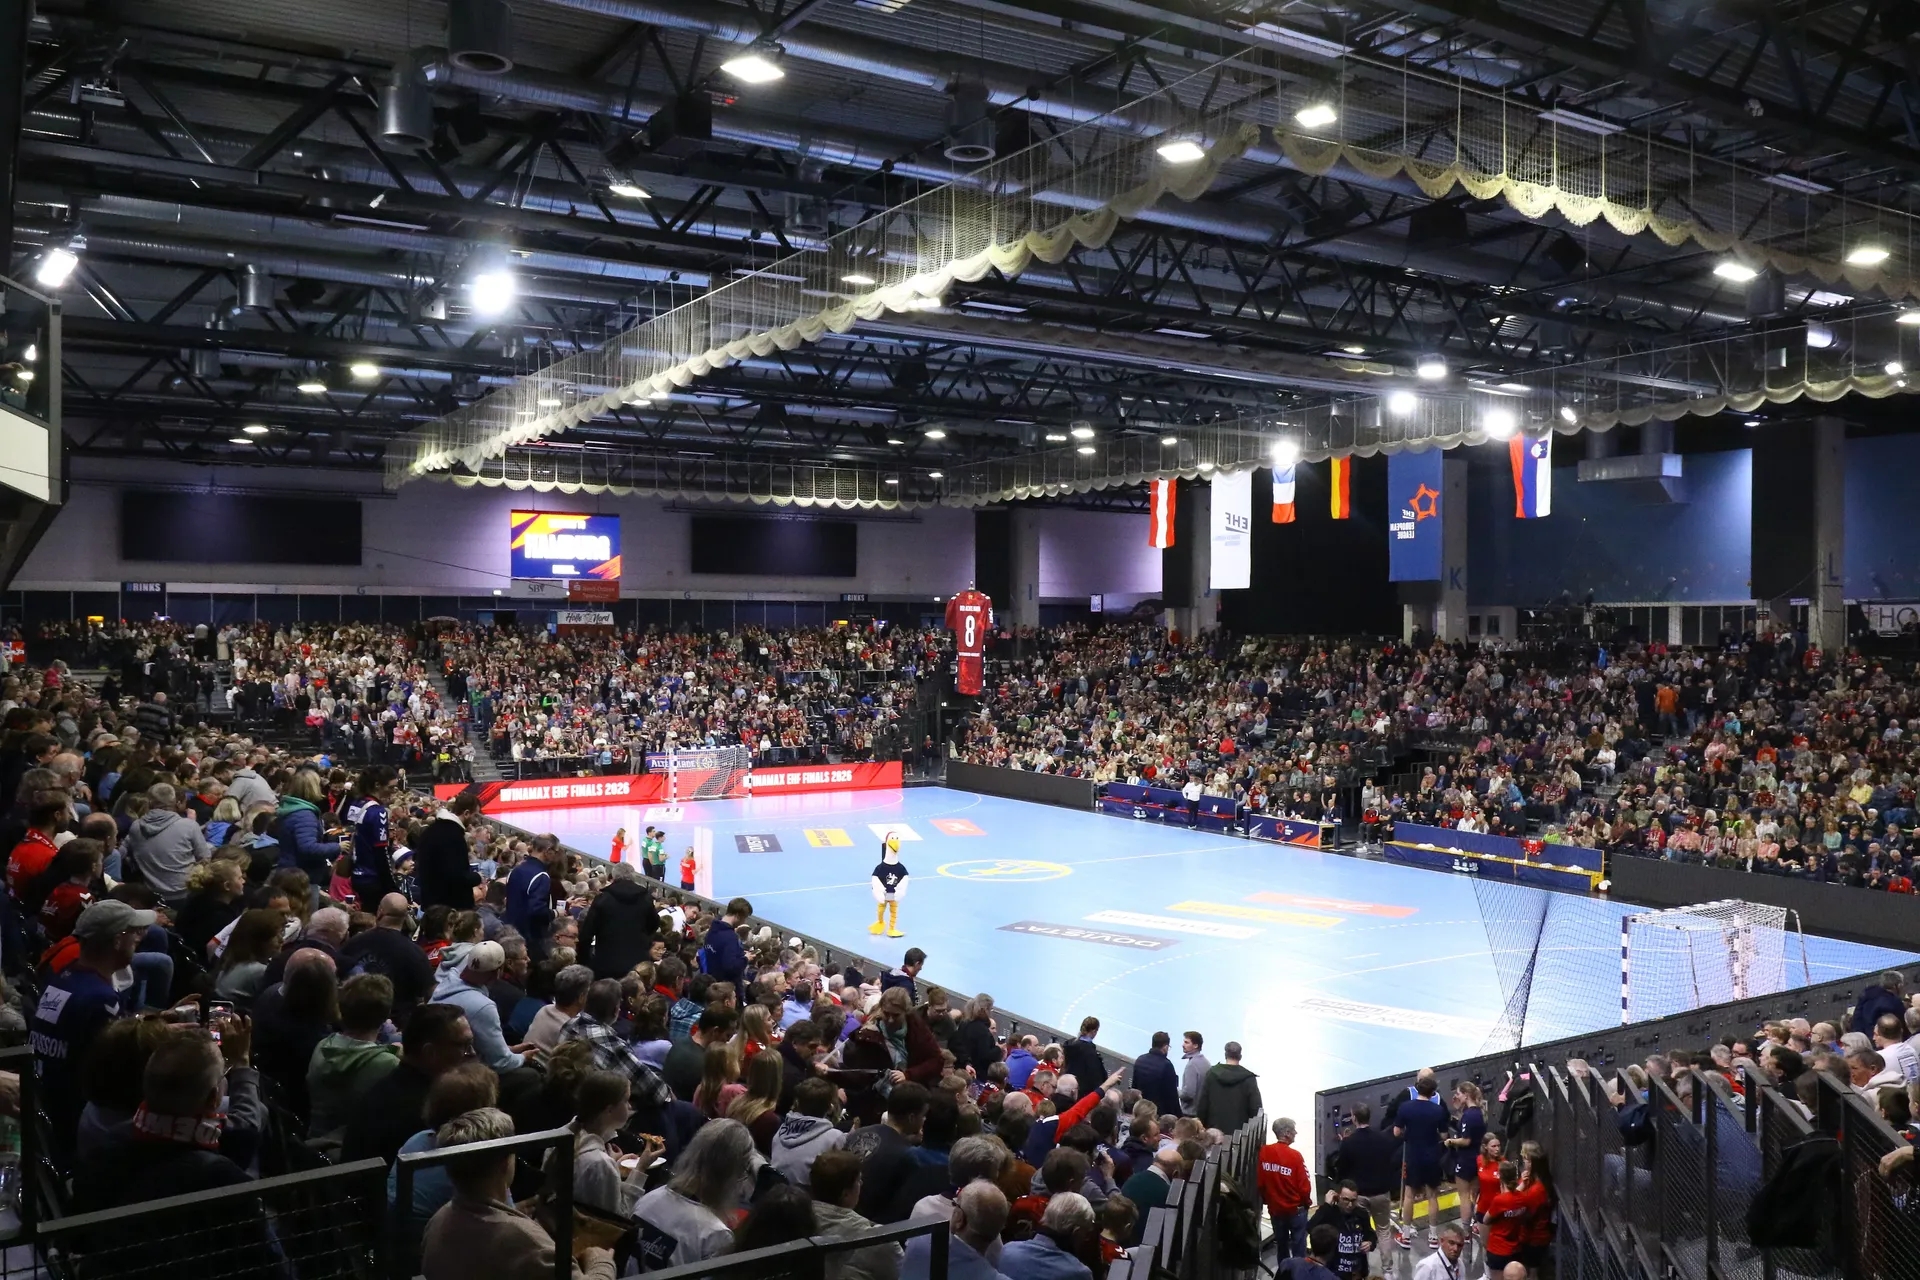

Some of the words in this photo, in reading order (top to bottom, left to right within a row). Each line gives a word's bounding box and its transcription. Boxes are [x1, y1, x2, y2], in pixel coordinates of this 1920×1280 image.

[1828, 552, 1839, 582] L
[127, 582, 161, 591] DRINKS
[1450, 566, 1464, 591] K
[965, 615, 975, 647] 8
[787, 774, 801, 786] EHF
[802, 771, 830, 785] FINALS
[831, 769, 852, 783] 2026
[500, 786, 550, 802] WINAMAX
[552, 785, 569, 799] EHF
[570, 783, 603, 798] FINALS
[604, 782, 630, 795] 2026
[1028, 924, 1162, 948] DOVISTA
[1262, 1162, 1292, 1176] VOLUNEER
